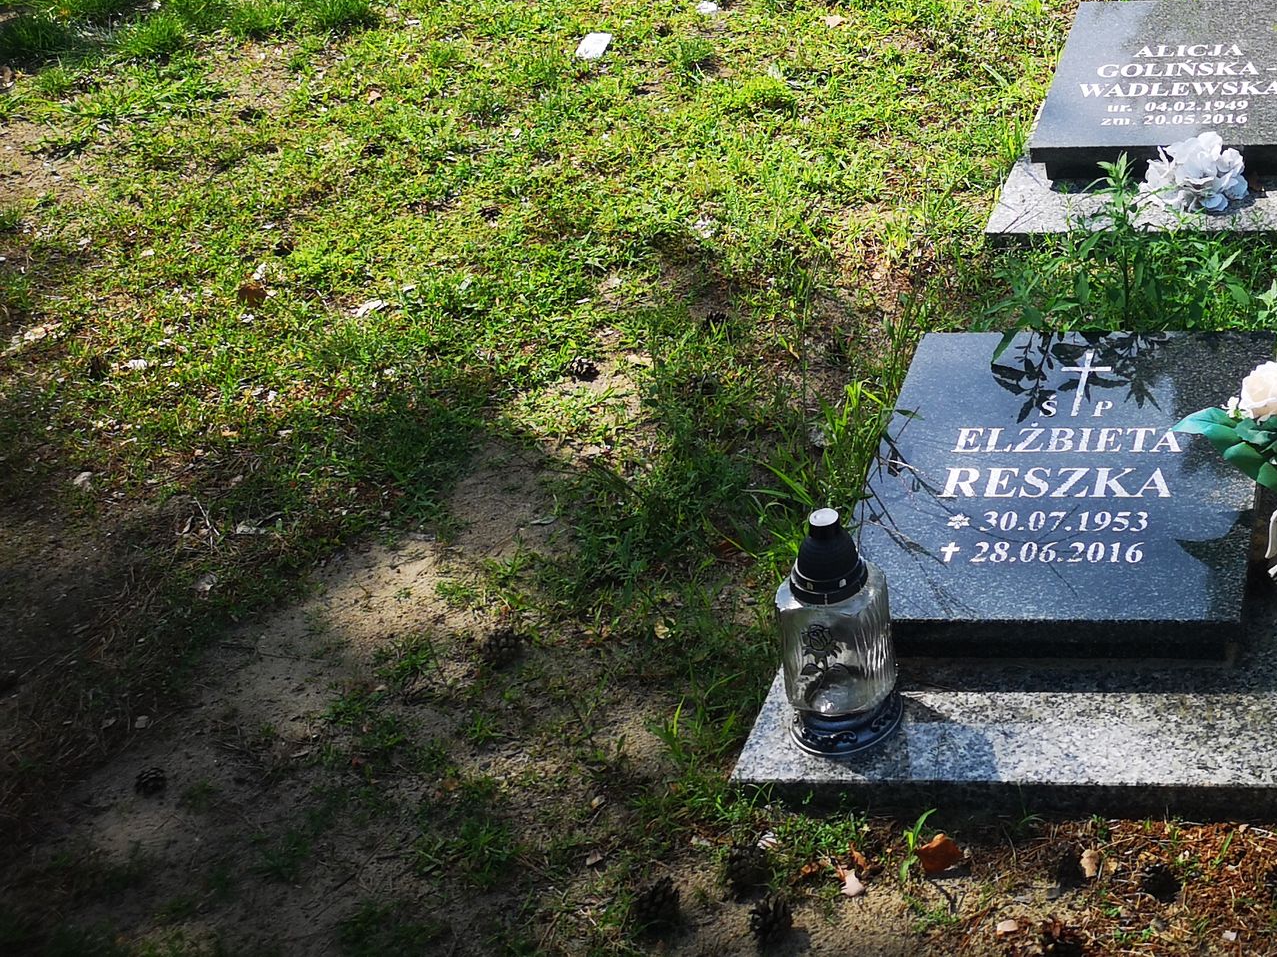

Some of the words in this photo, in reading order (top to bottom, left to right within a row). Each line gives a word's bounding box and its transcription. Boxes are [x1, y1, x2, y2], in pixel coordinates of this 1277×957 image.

[1133, 43, 1245, 57] ALICJA
[1096, 60, 1260, 78] GOLIŃSKA
[1107, 103, 1133, 113] ur.
[1144, 100, 1249, 112] 04.02.1949
[1101, 117, 1137, 126] zm.
[1143, 113, 1248, 125] 20.05.2016
[1092, 400, 1113, 417] P
[951, 422, 1183, 453] ELŻBIETA
[937, 467, 1172, 498] RESZKA
[979, 511, 1149, 532] 30.07.1953
[969, 541, 1145, 563] 28.06.2016
